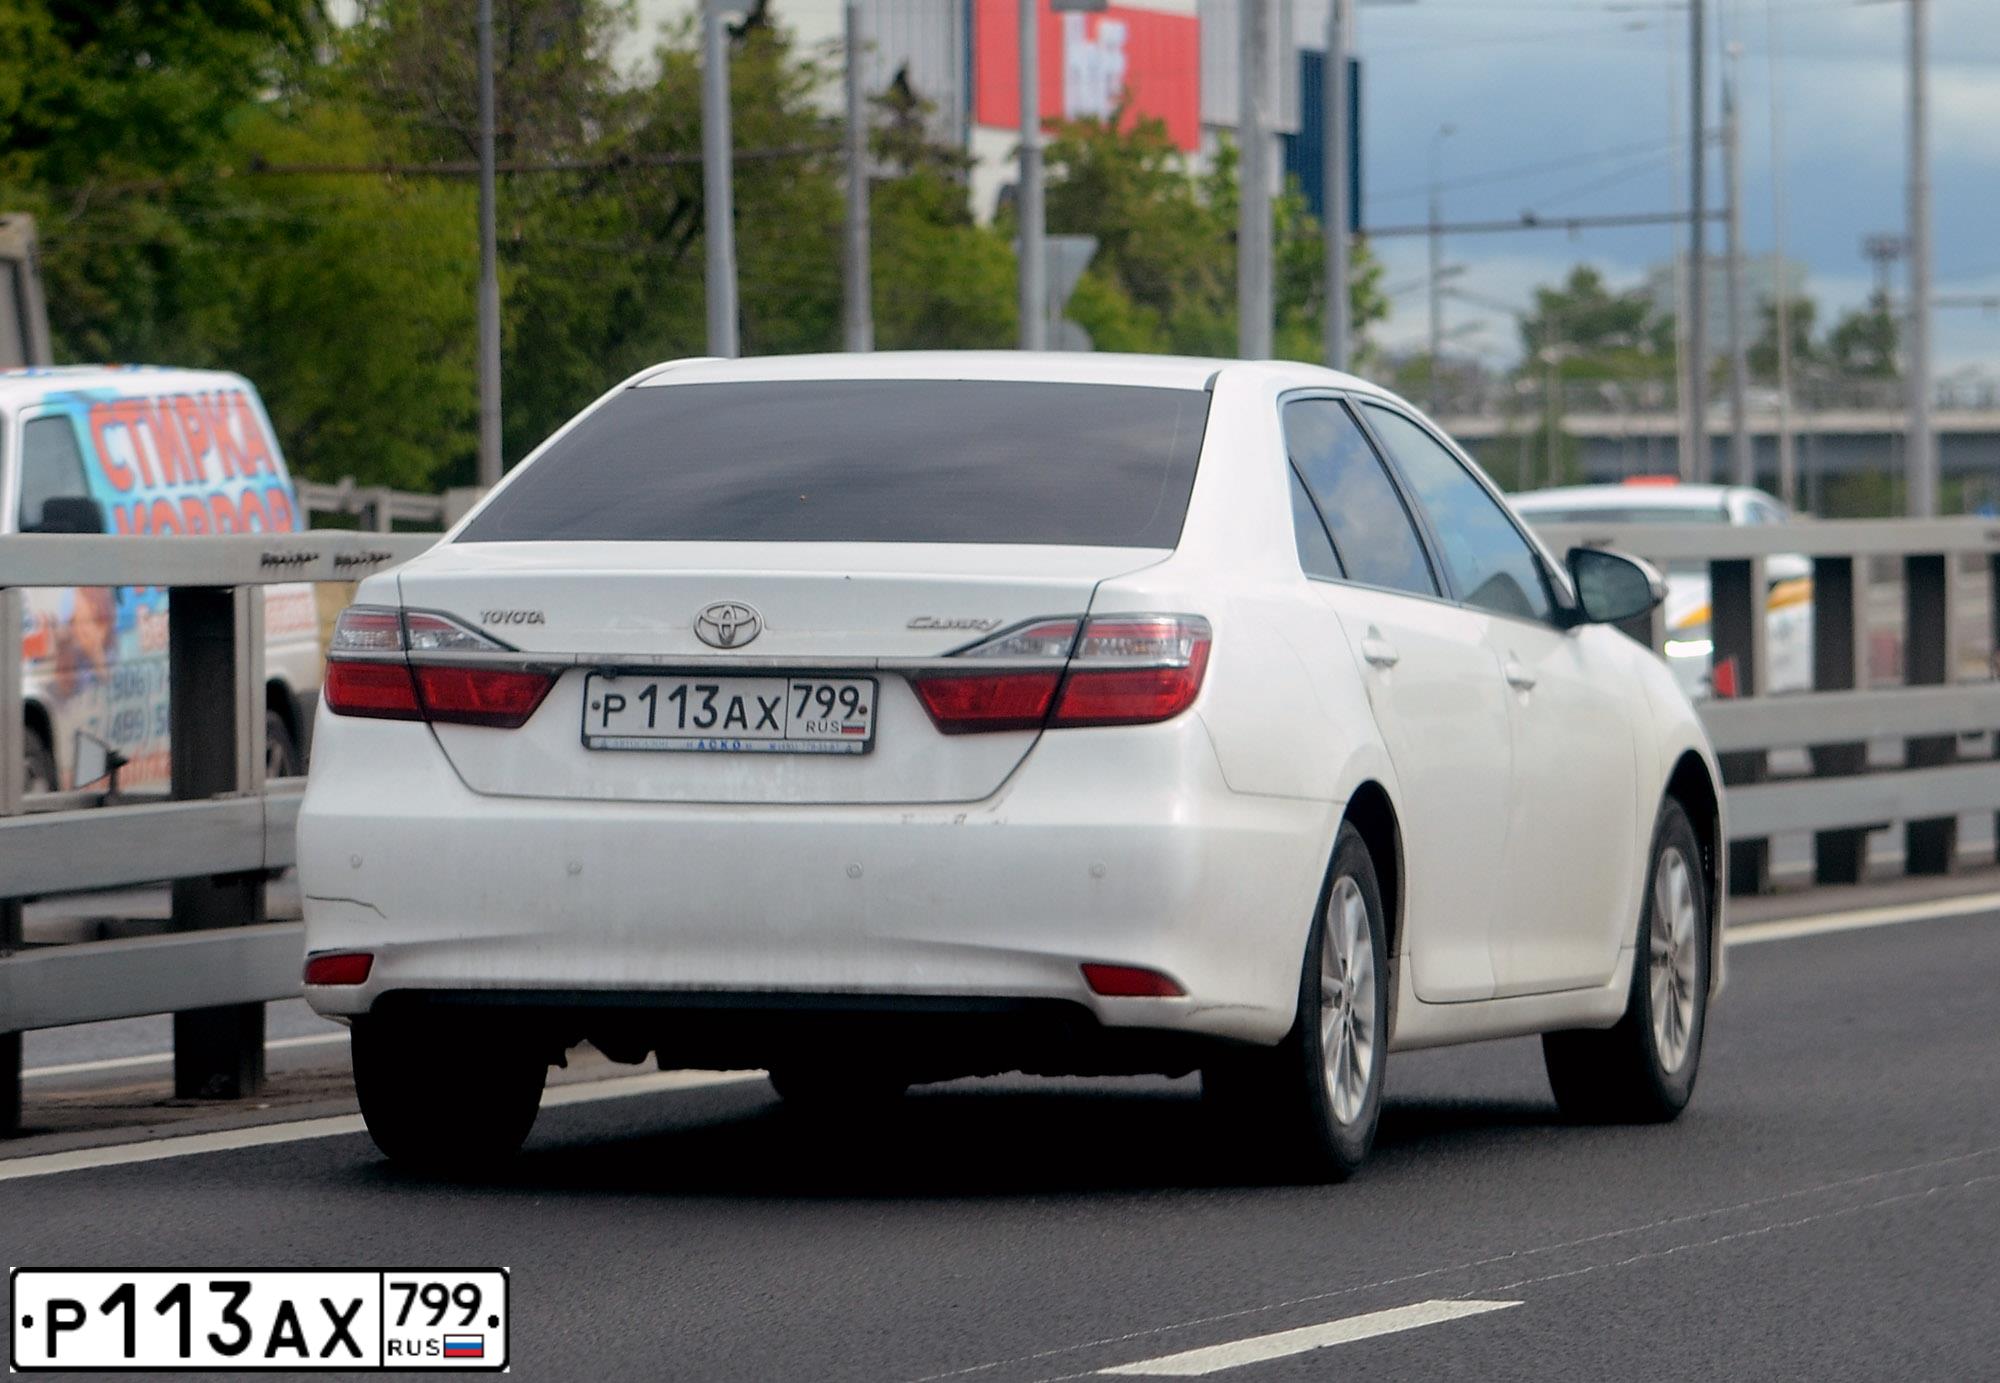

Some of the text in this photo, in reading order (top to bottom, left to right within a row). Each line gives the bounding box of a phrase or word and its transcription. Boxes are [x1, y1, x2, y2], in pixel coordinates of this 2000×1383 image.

[90, 389, 278, 492] СТИРКА
[481, 609, 545, 625] TOYOTA
[792, 684, 860, 720] 799
[805, 720, 839, 734] RUS
